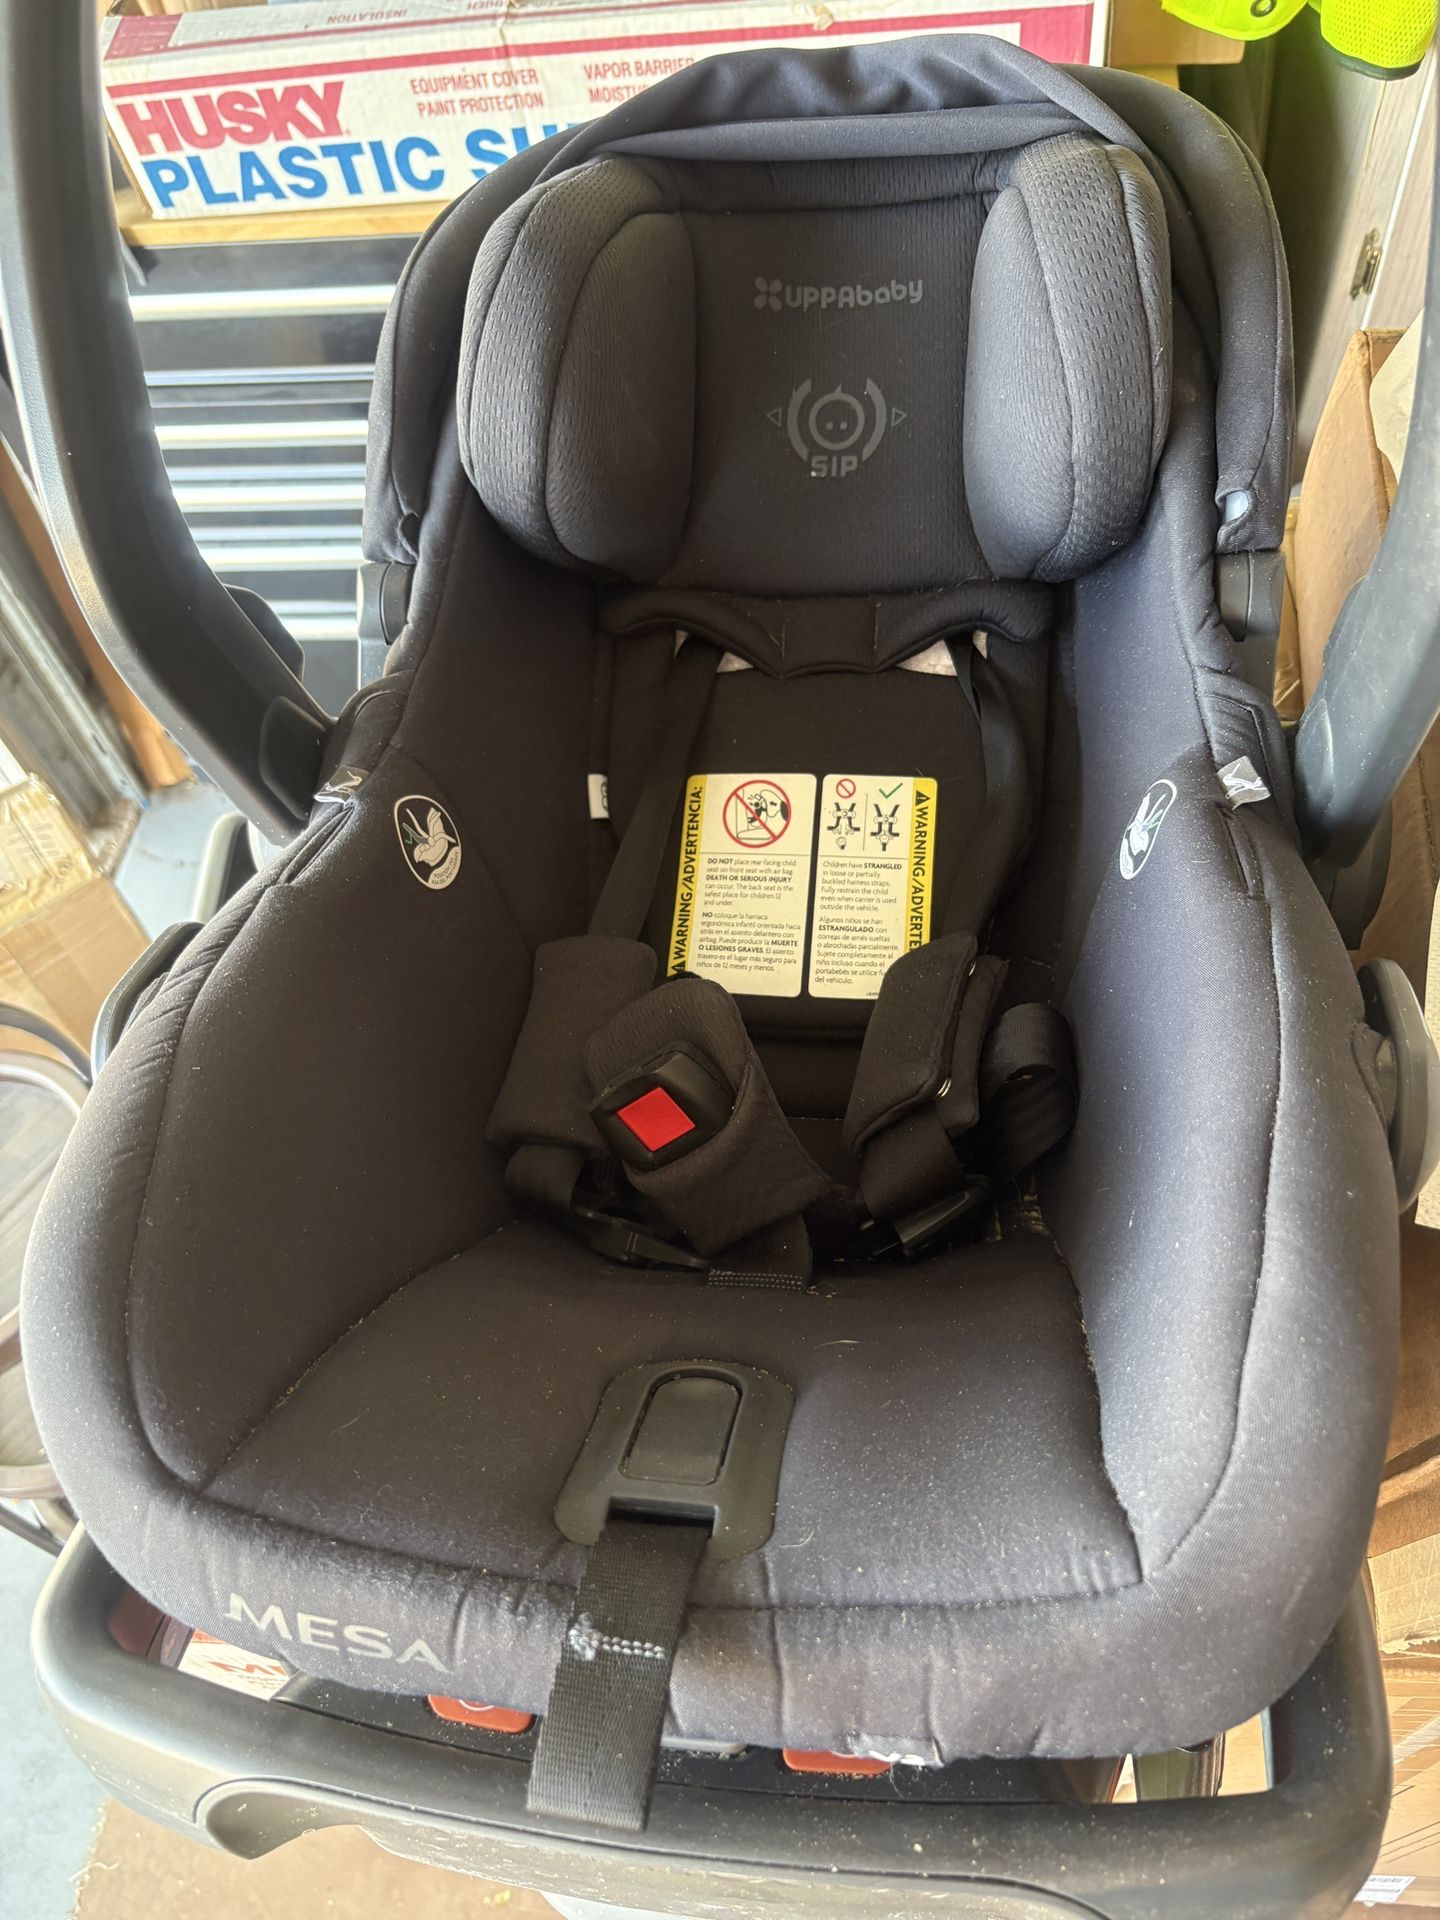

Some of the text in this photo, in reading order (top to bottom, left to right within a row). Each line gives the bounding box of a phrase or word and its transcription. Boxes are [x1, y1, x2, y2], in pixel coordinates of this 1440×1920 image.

[410, 68, 538, 94] EQUIPMENT COVER
[584, 61, 632, 80] VAPOR
[417, 92, 544, 117] PAINT PROTECTION
[116, 81, 344, 156] HUSKY
[140, 136, 444, 208] PLASTIC
[811, 456, 858, 477] SIP
[674, 786, 703, 960] WARNING/ADVERTENCIA:
[856, 871, 880, 879] partially
[910, 806, 928, 950] WARNING/ADVERTE
[821, 886, 835, 894] Fully
[734, 954, 748, 962] lugar
[817, 950, 836, 958] Sujete
[223, 1593, 455, 1674] MESA
